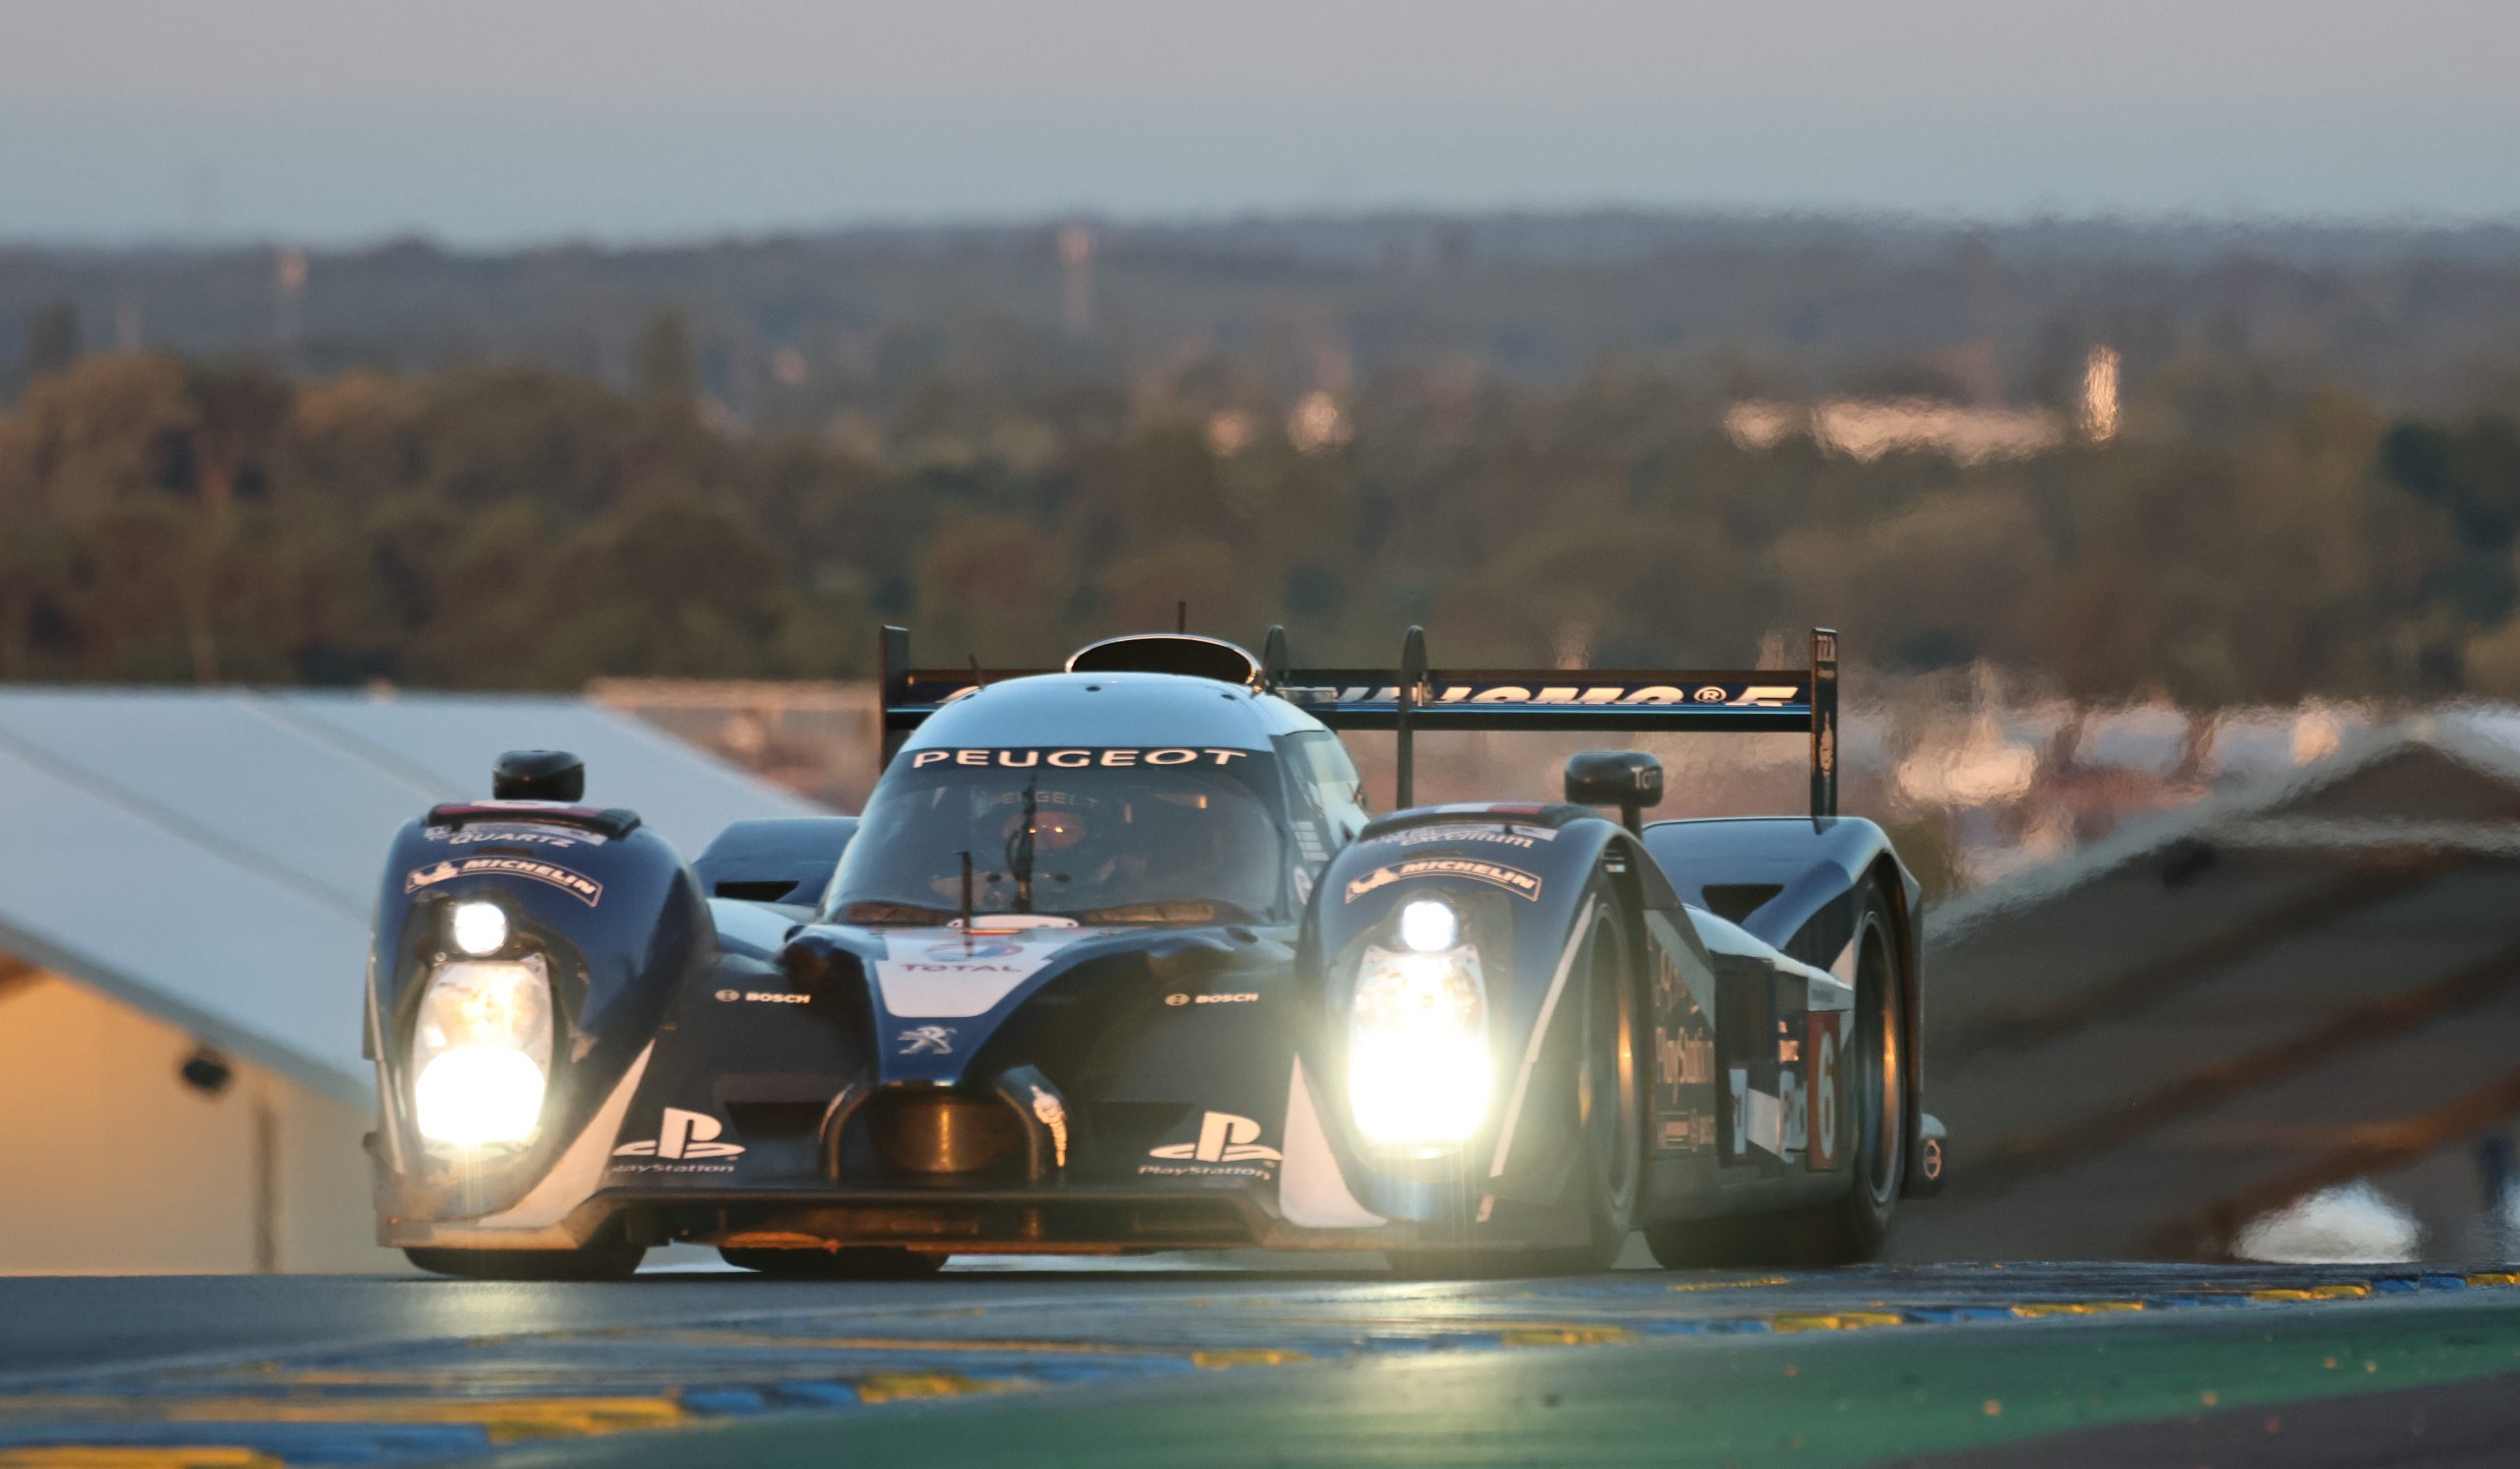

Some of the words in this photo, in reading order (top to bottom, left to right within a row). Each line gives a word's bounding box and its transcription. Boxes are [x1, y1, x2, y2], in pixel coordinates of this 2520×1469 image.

[914, 748, 1247, 768] PEUGEOT
[449, 833, 576, 848] QUARTZ
[462, 860, 597, 894] MICHELIN
[1399, 861, 1537, 889] MICHELIN
[745, 991, 810, 1003] BOSCH
[1195, 992, 1259, 1003] BOSCH
[1817, 1032, 1835, 1159] 6
[1137, 1165, 1272, 1181] PlayStation
